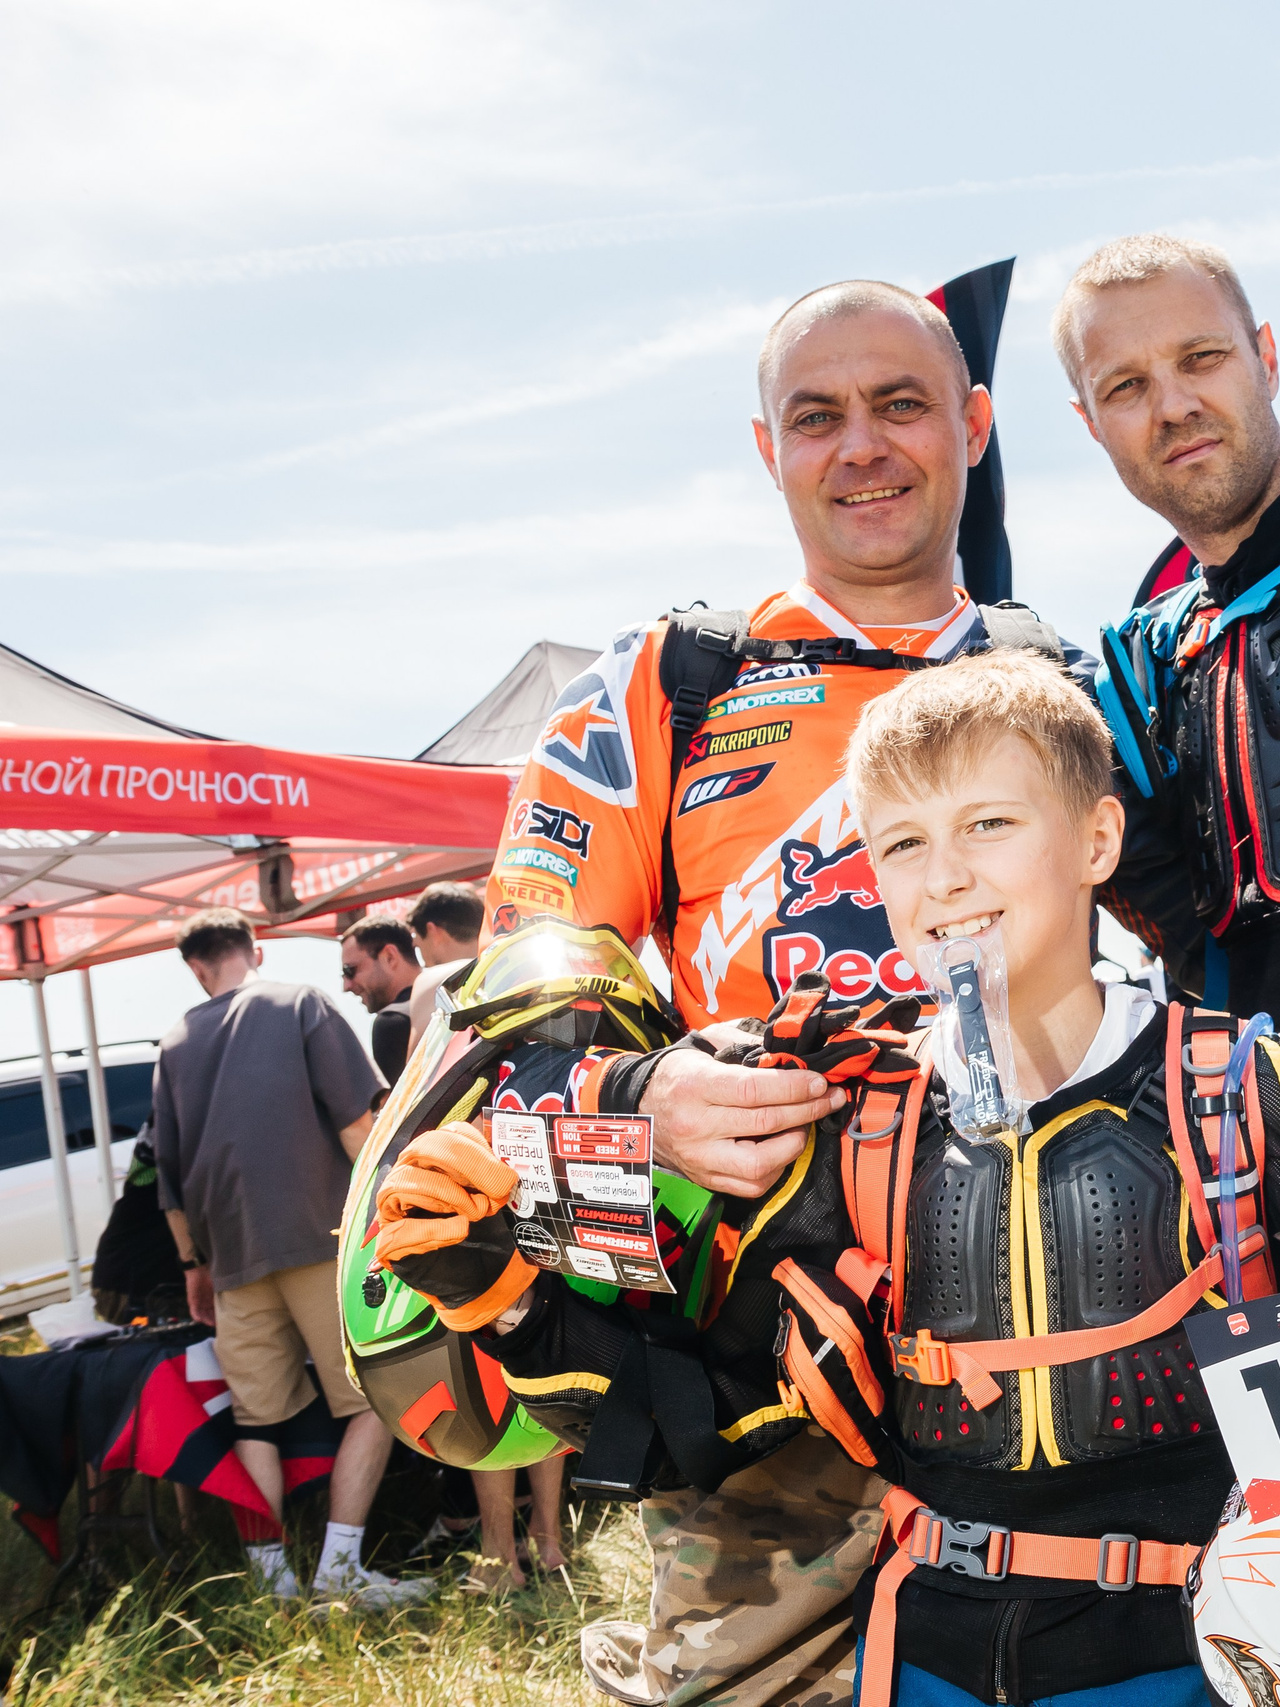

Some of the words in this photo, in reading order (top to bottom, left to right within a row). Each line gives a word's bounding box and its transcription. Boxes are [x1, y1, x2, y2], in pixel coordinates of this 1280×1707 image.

[726, 686, 821, 715] MOTOREX
[0, 756, 93, 796] НОЙ
[99, 764, 310, 807] ПРОЧНОСТИ
[684, 769, 761, 810] WP
[515, 848, 576, 885] MOTOREX
[497, 1144, 543, 1159] ПРЕДЕЛЫ
[532, 1164, 546, 1176] ЗА
[570, 1169, 593, 1179] ВЫЗОВ
[594, 1171, 620, 1181] НОВЫЙ
[592, 1185, 611, 1195] ДЕНЬ
[611, 1187, 638, 1197] НОВЫЙ
[575, 1208, 645, 1225] SHARMAX
[582, 1233, 649, 1252] SHARMAX
